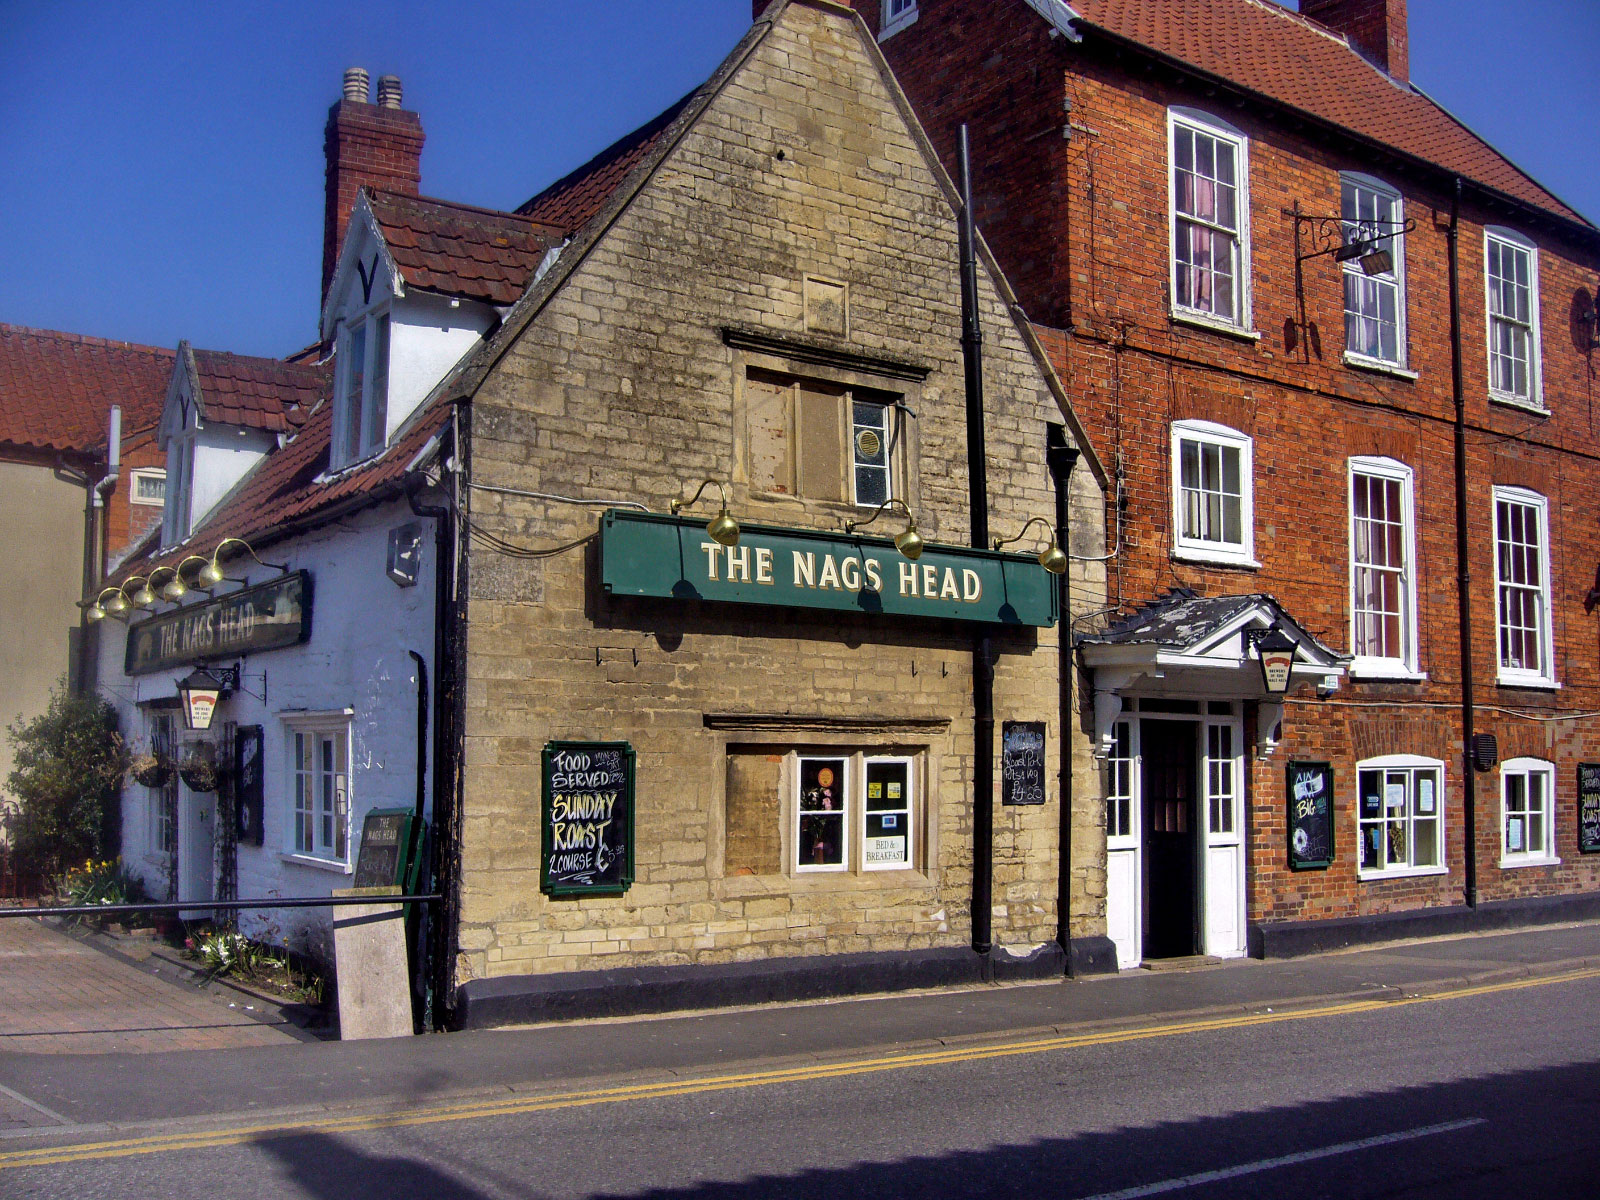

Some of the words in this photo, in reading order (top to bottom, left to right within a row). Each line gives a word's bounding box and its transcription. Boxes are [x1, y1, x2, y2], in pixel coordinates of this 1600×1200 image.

[701, 542, 774, 585] THE
[792, 551, 883, 593] NAGS
[898, 561, 982, 603] HEAD
[160, 622, 179, 658] THE
[183, 612, 214, 650] NAGS
[219, 602, 255, 643] HEAD
[553, 751, 591, 772] FOOD
[552, 771, 609, 788] SERVED
[552, 793, 617, 822] SUNDAY
[380, 817, 390, 828] THE
[383, 829, 397, 840] HEAD
[554, 819, 612, 850] ROAST
[875, 840, 889, 850] BED
[890, 840, 895, 849] &
[549, 854, 557, 874] 2
[557, 851, 592, 873] COURSE
[866, 850, 904, 861] BREAKFAST
